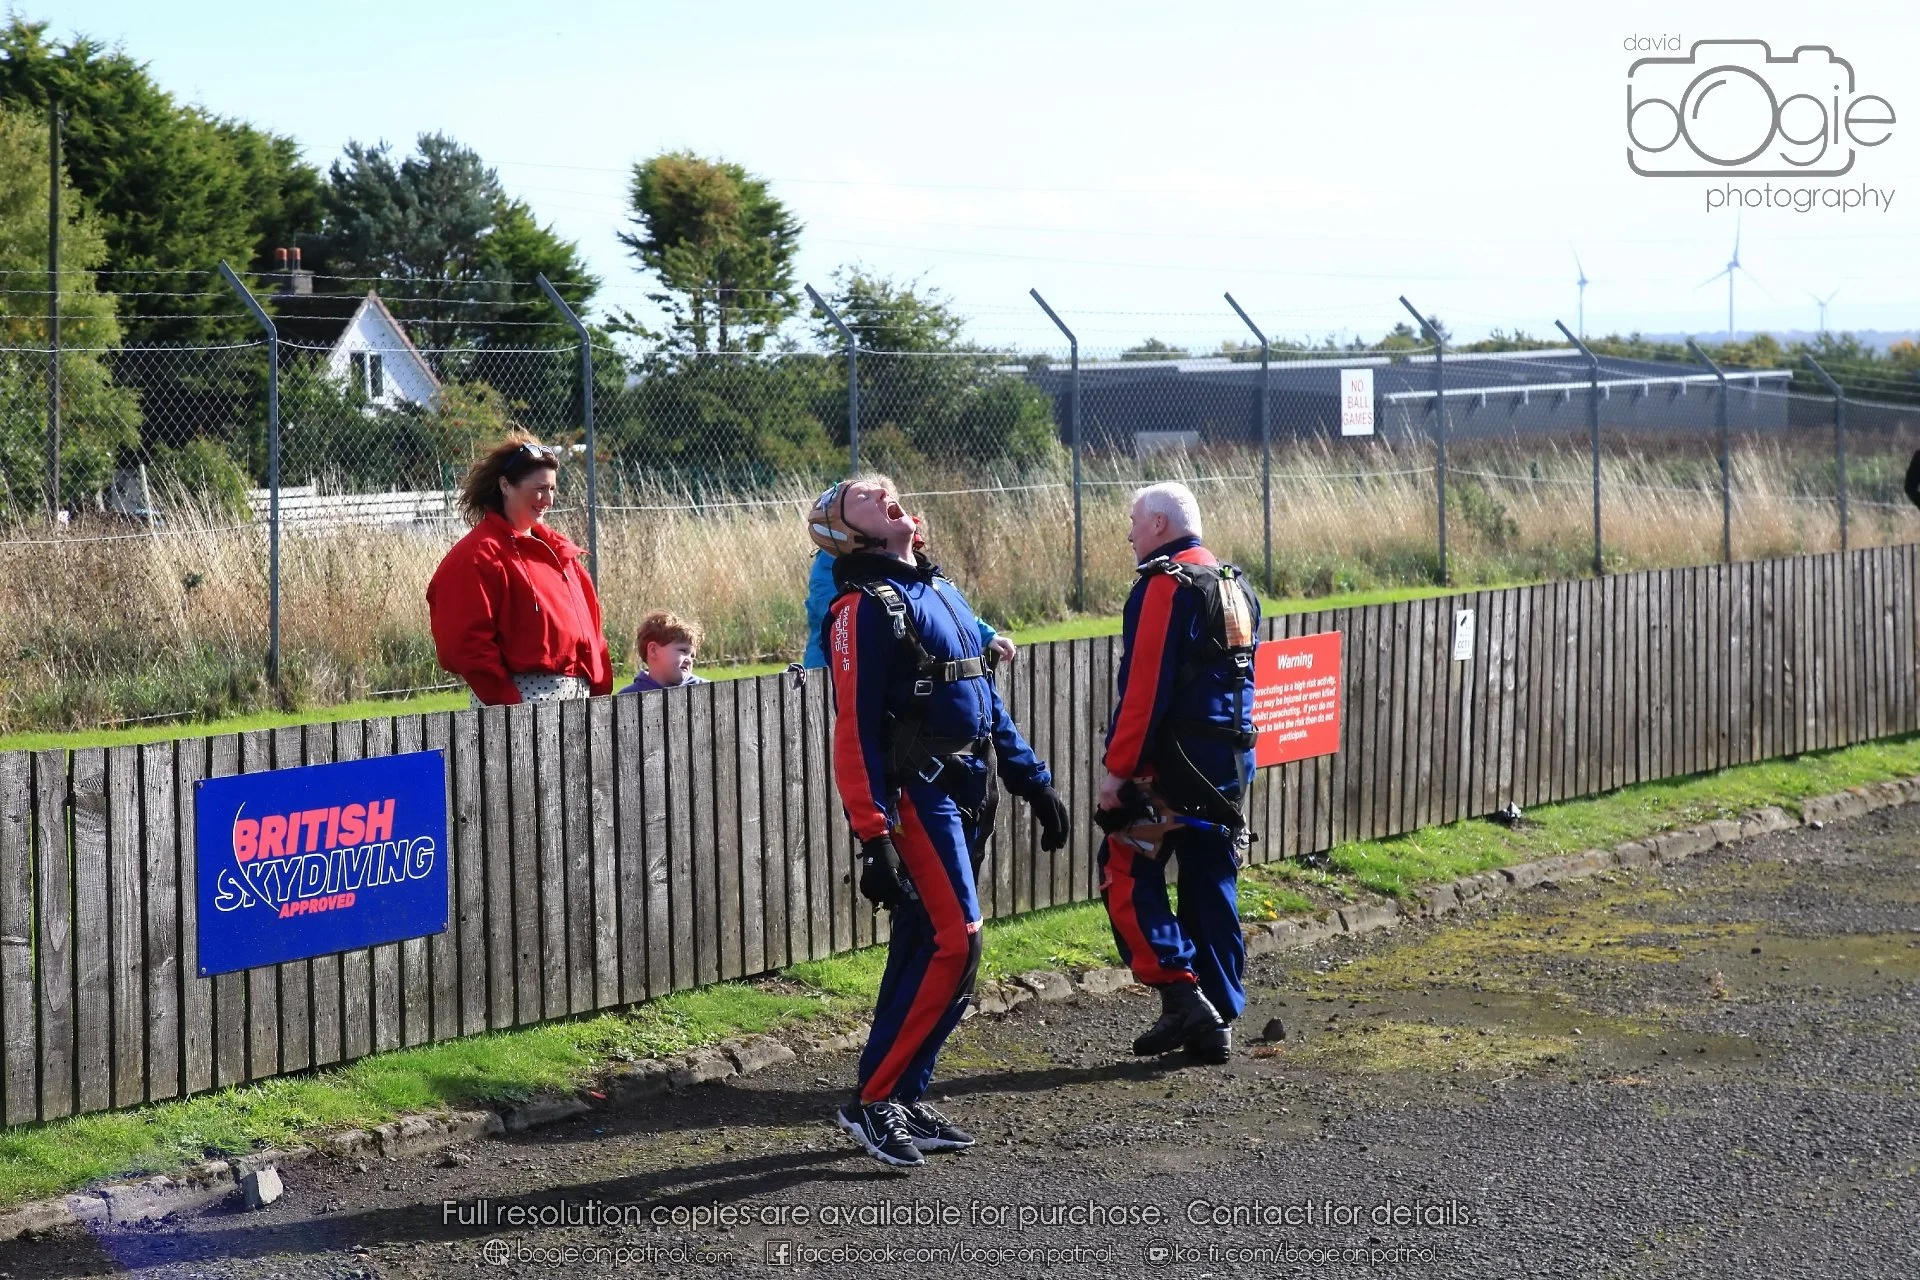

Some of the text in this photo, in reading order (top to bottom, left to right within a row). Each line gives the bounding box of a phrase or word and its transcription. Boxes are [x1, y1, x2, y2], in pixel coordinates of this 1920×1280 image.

[1351, 380, 1364, 392] NO
[1347, 396, 1369, 409] BALL
[1343, 411, 1373, 426] GAMES
[842, 605, 850, 655] Andrews
[1278, 652, 1313, 669] Warning
[1307, 679, 1316, 688] risk
[234, 799, 395, 863] BRITISH
[215, 835, 435, 912] SKYDIVING
[278, 892, 356, 919] APPROVED
